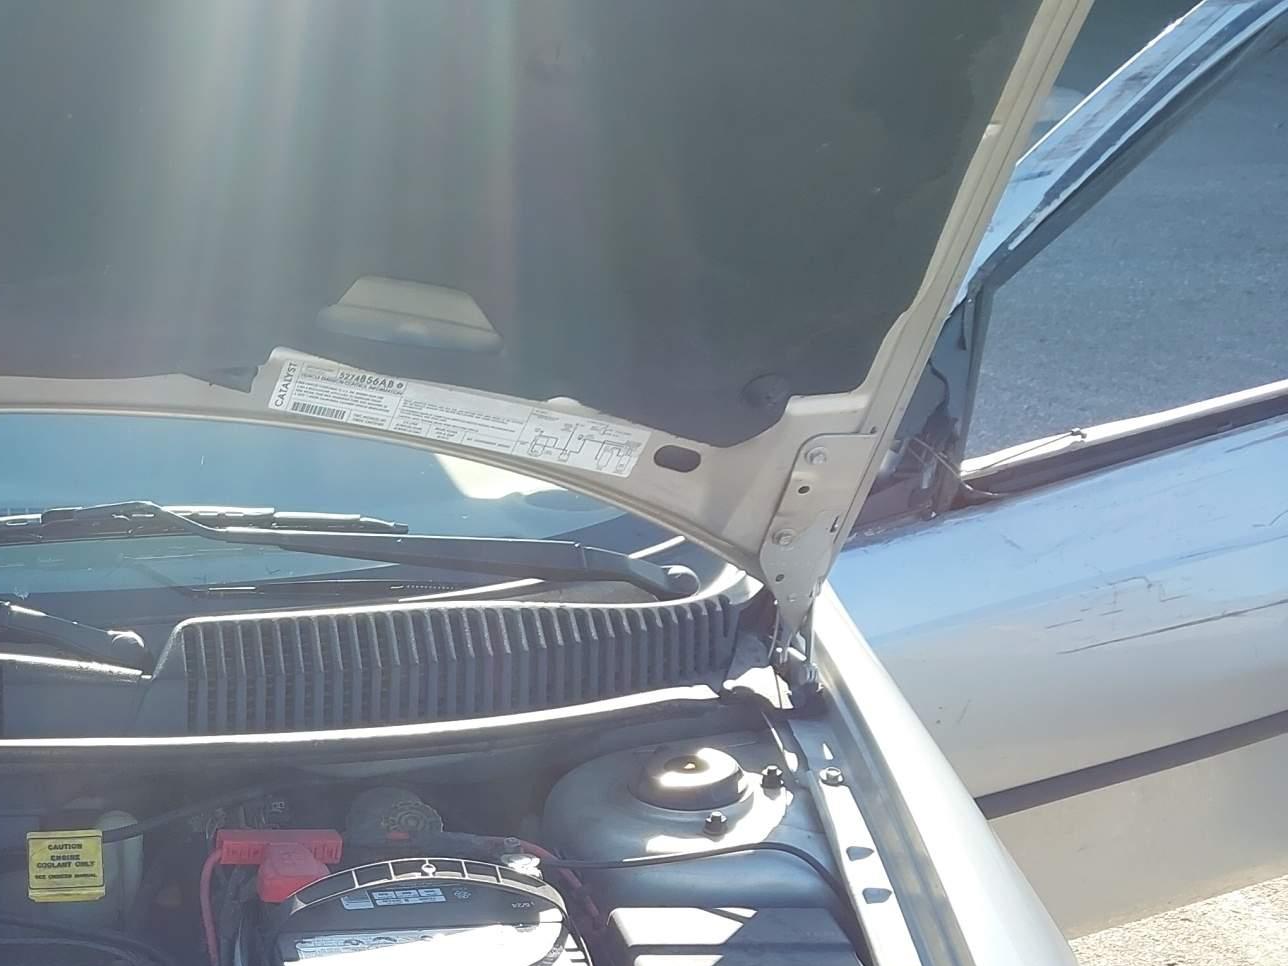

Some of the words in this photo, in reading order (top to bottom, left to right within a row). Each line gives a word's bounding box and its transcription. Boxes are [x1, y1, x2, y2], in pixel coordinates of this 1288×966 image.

[275, 362, 298, 407] CATALYST
[47, 842, 83, 851] CAUTION
[50, 854, 81, 862] ENGINE
[36, 861, 72, 869] COOLANT
[75, 860, 96, 868] ONLY
